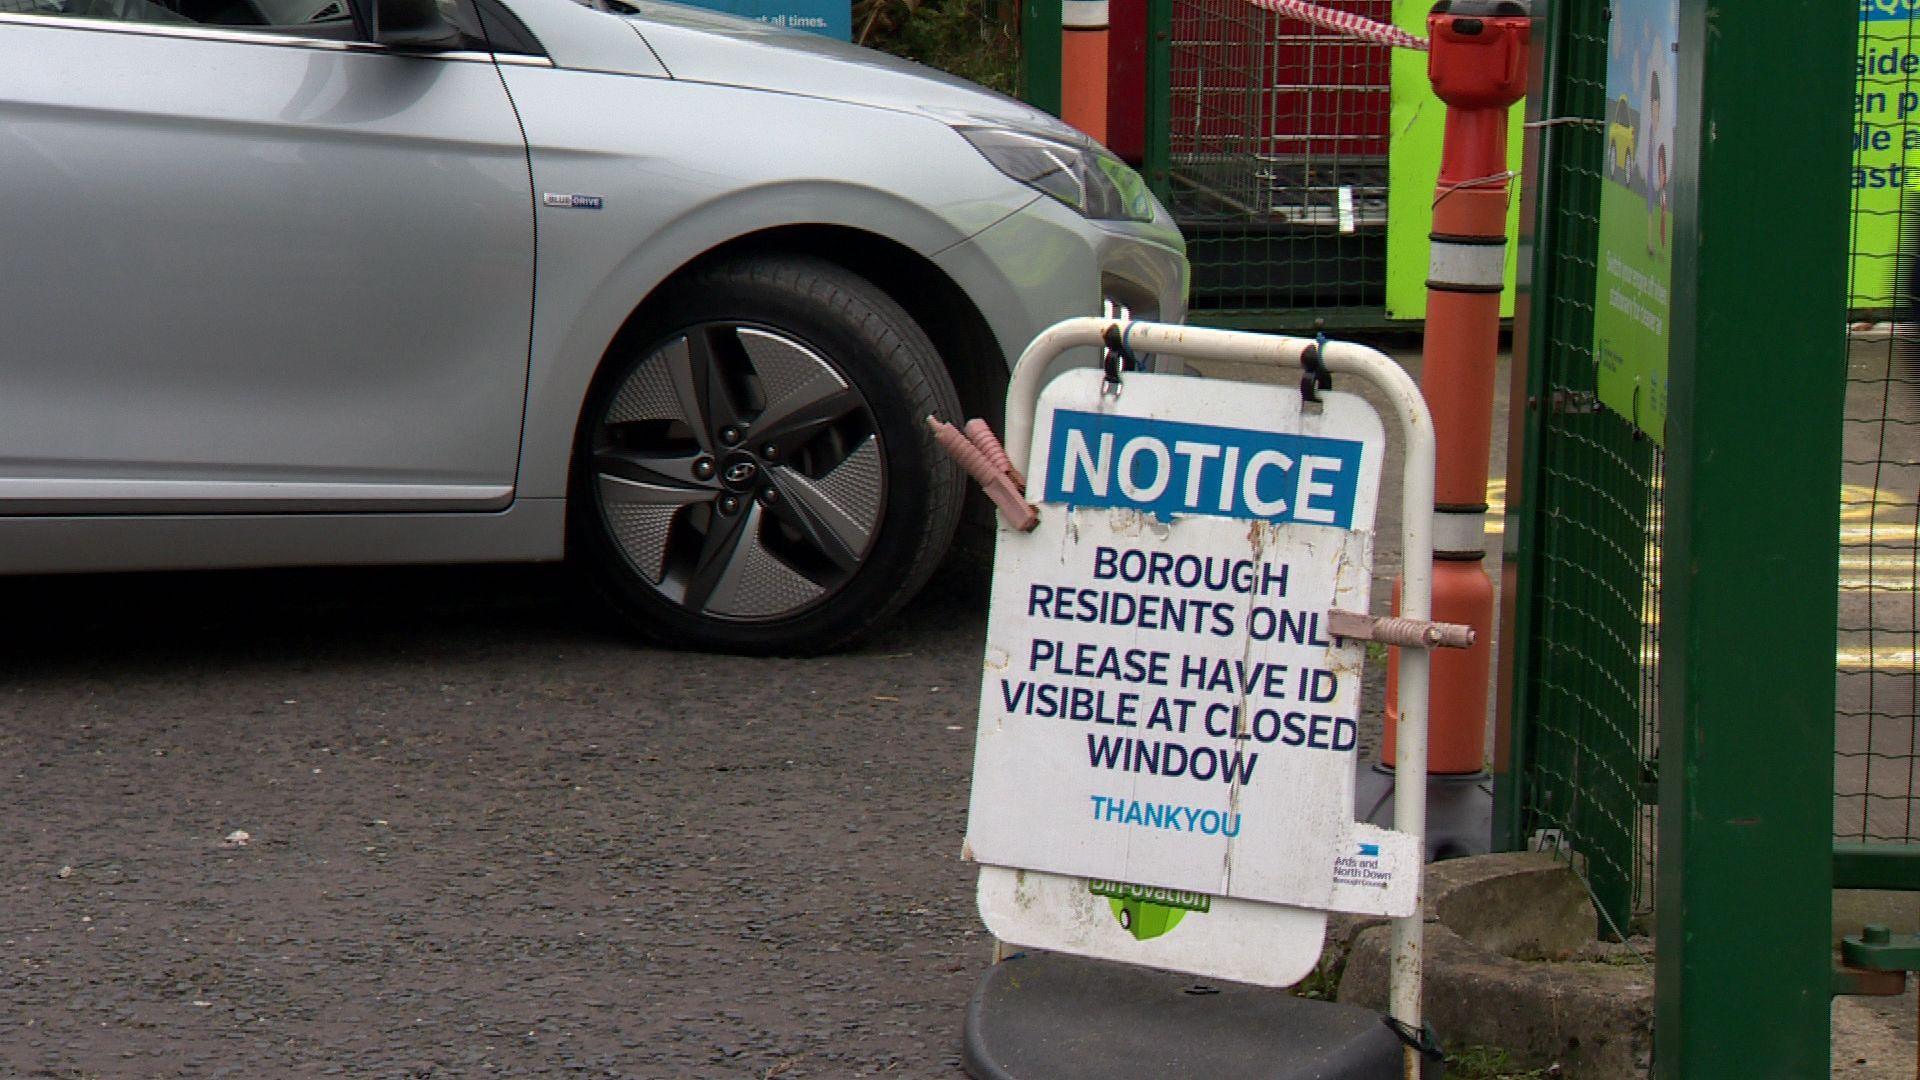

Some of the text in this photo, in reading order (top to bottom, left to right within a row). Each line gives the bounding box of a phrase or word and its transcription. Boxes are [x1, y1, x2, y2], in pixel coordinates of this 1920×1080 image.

[788, 14, 828, 28] times.
[1060, 428, 1343, 524] NOTICE
[1093, 546, 1289, 597] BOROUGH
[1028, 584, 1346, 650] RESIDENTS ONL
[1028, 639, 1337, 704] PLEASE HAVE ID
[1001, 678, 1357, 752] VISIBLE AT CLOSED
[1087, 733, 1258, 786] WINDOW
[1090, 794, 1242, 838] THANKYOU
[1333, 866, 1392, 881] North Down
[1334, 856, 1378, 869] Ards and
